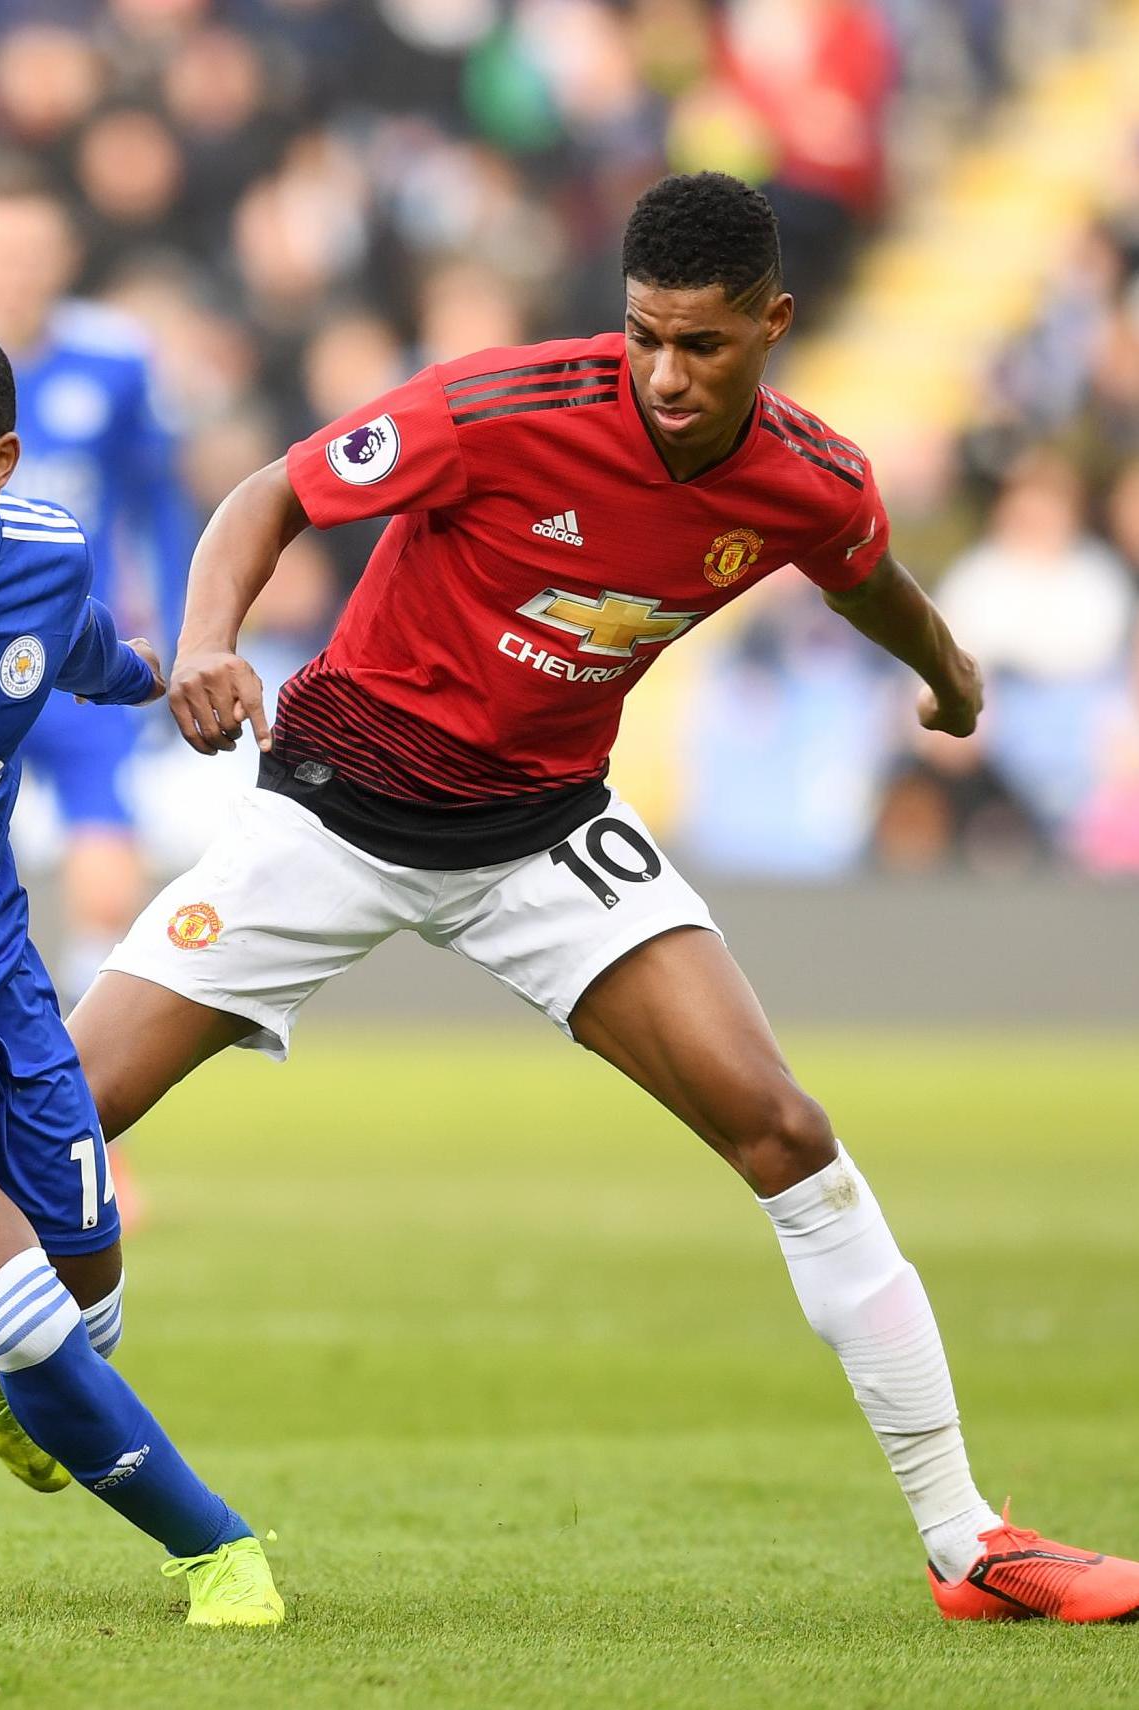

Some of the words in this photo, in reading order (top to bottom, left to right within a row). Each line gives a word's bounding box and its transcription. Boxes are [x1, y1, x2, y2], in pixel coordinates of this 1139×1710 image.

[532, 523, 584, 547] adidas
[709, 572, 740, 583] UNITED
[548, 817, 662, 911] 10
[170, 932, 198, 948] UNITED
[93, 1444, 151, 1490] adidas
